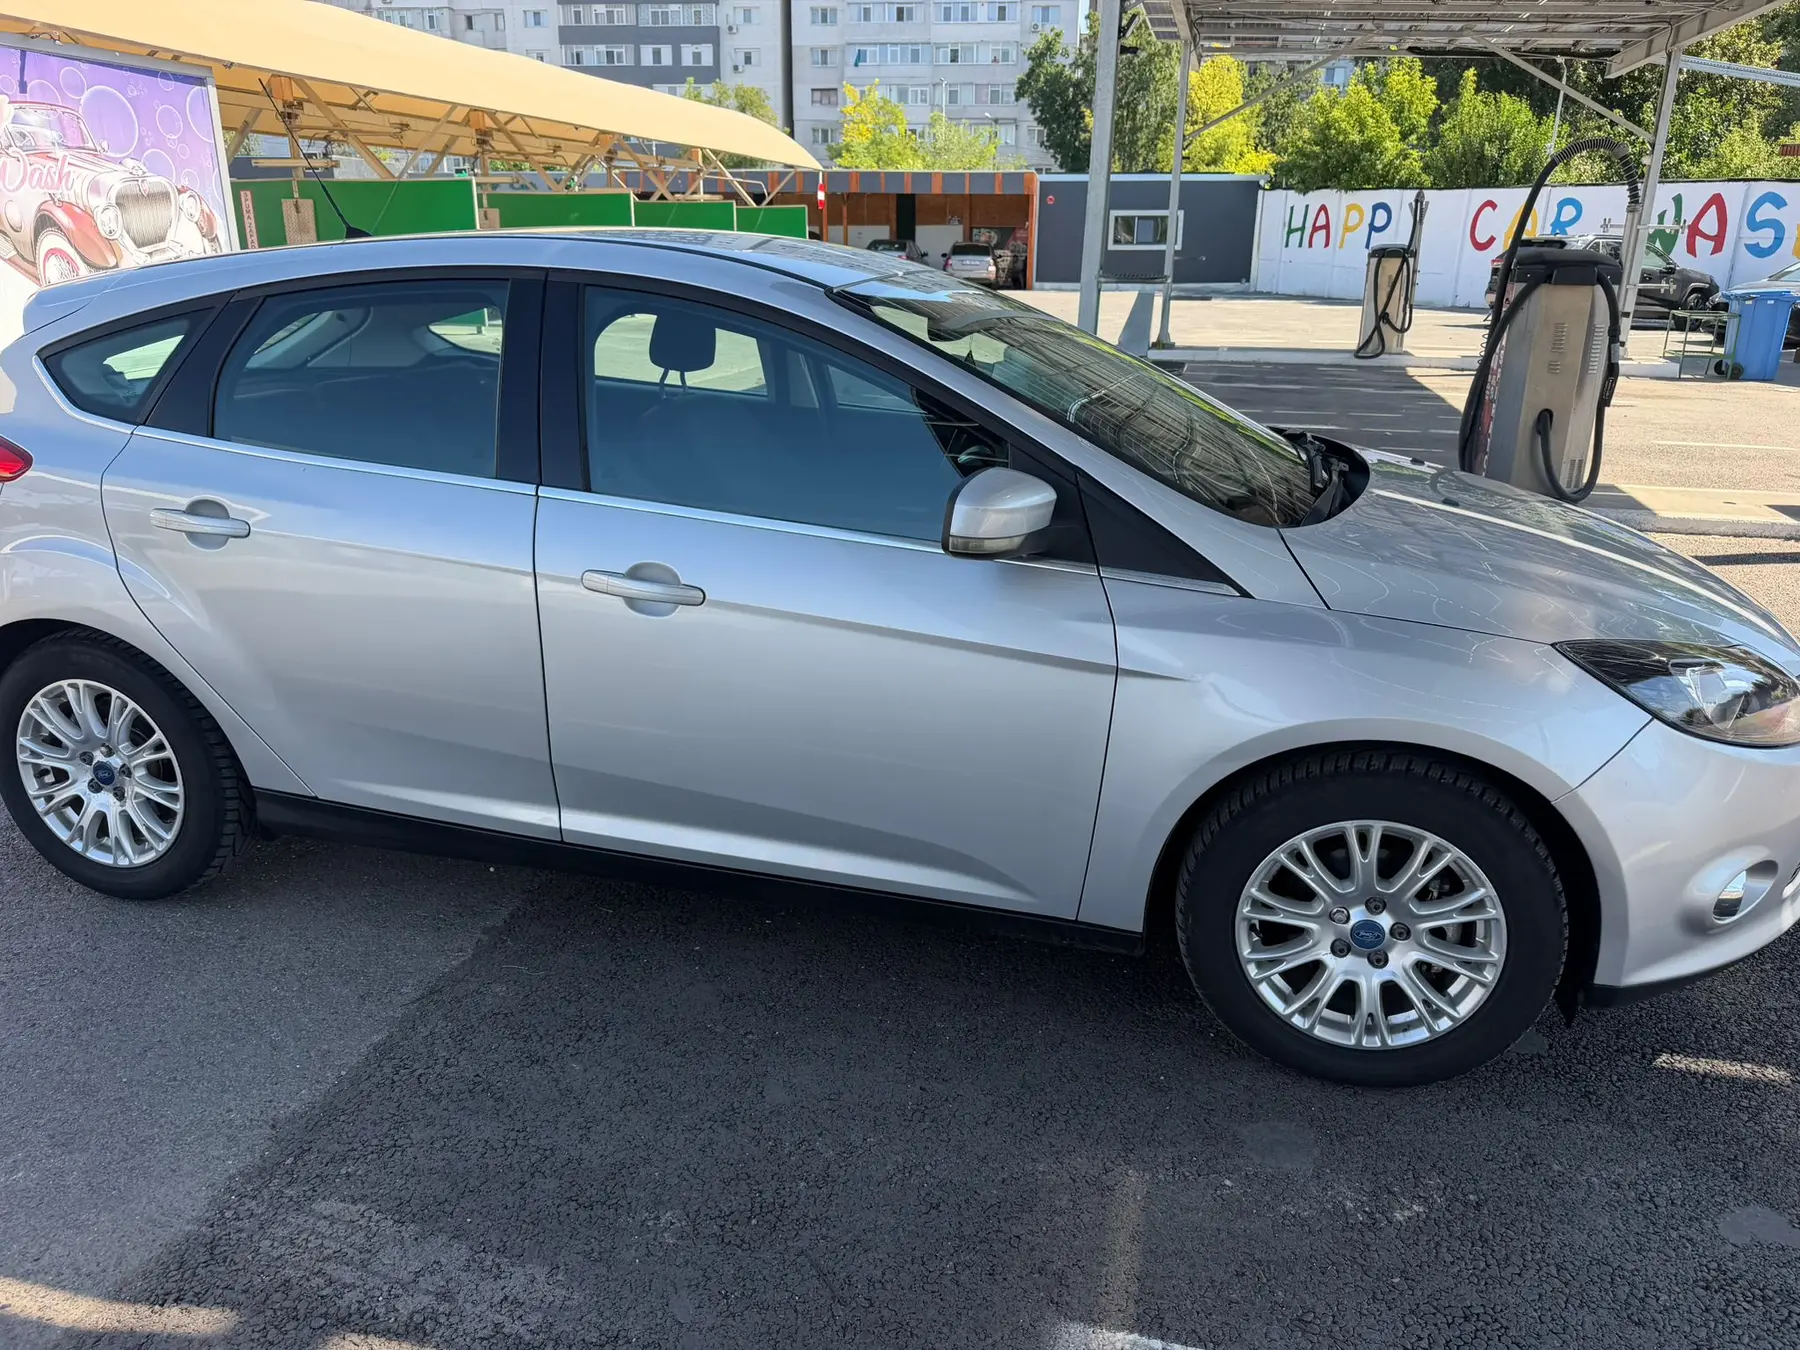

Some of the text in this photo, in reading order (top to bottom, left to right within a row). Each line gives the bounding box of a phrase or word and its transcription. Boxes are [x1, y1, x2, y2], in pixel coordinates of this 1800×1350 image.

[243, 192, 252, 220] SPUMA
[1470, 197, 1582, 251] CAR
[1645, 190, 1800, 258] WAS
